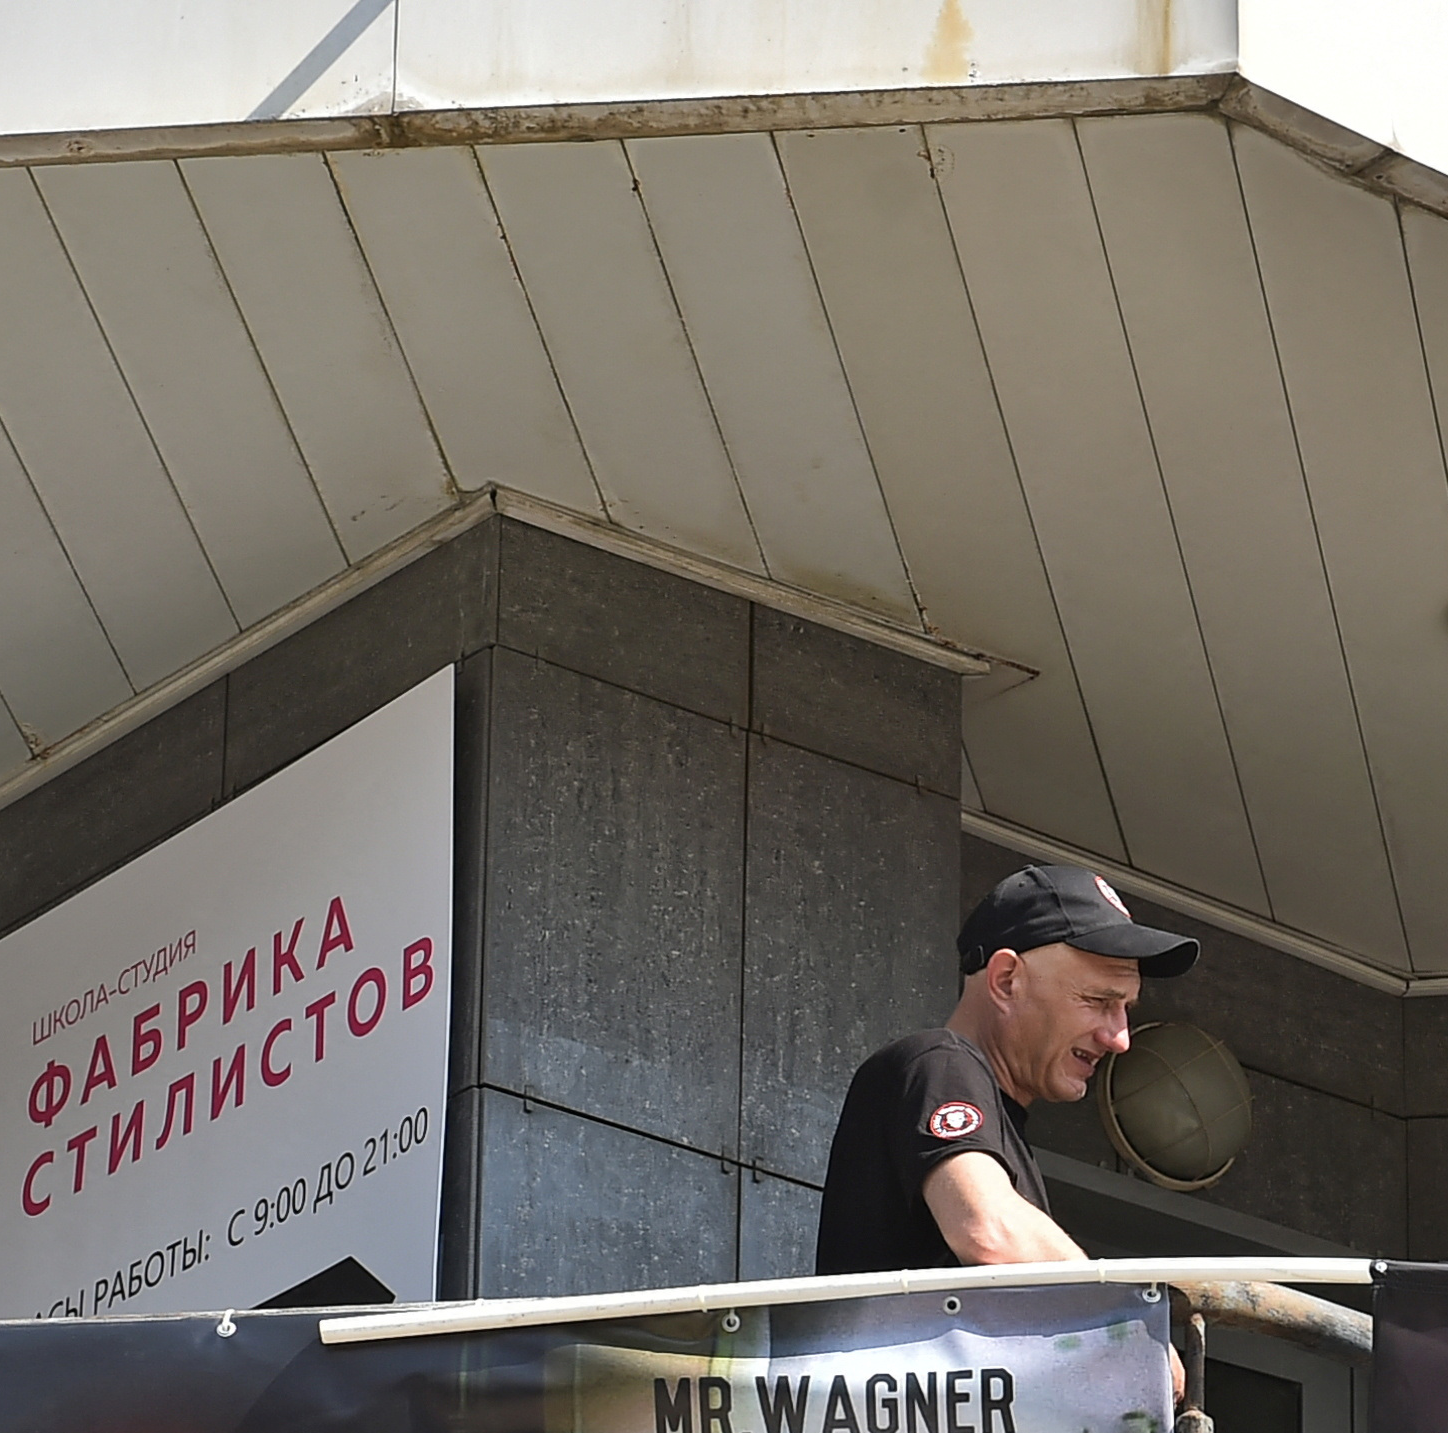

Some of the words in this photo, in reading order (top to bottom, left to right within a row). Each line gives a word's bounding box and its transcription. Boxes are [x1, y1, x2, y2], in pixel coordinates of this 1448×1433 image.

[20, 936, 435, 1218] СТИЛИСТОВ
[26, 895, 355, 1129] ФАБРИКА
[31, 929, 197, 1046] ШКОЛА-СТУДИЯ
[92, 1228, 212, 1315] РАБОТЫ:
[226, 1208, 246, 1248] С
[253, 1178, 307, 1237] 9:00
[311, 1152, 356, 1215] ДО
[362, 1106, 429, 1180] 21:00
